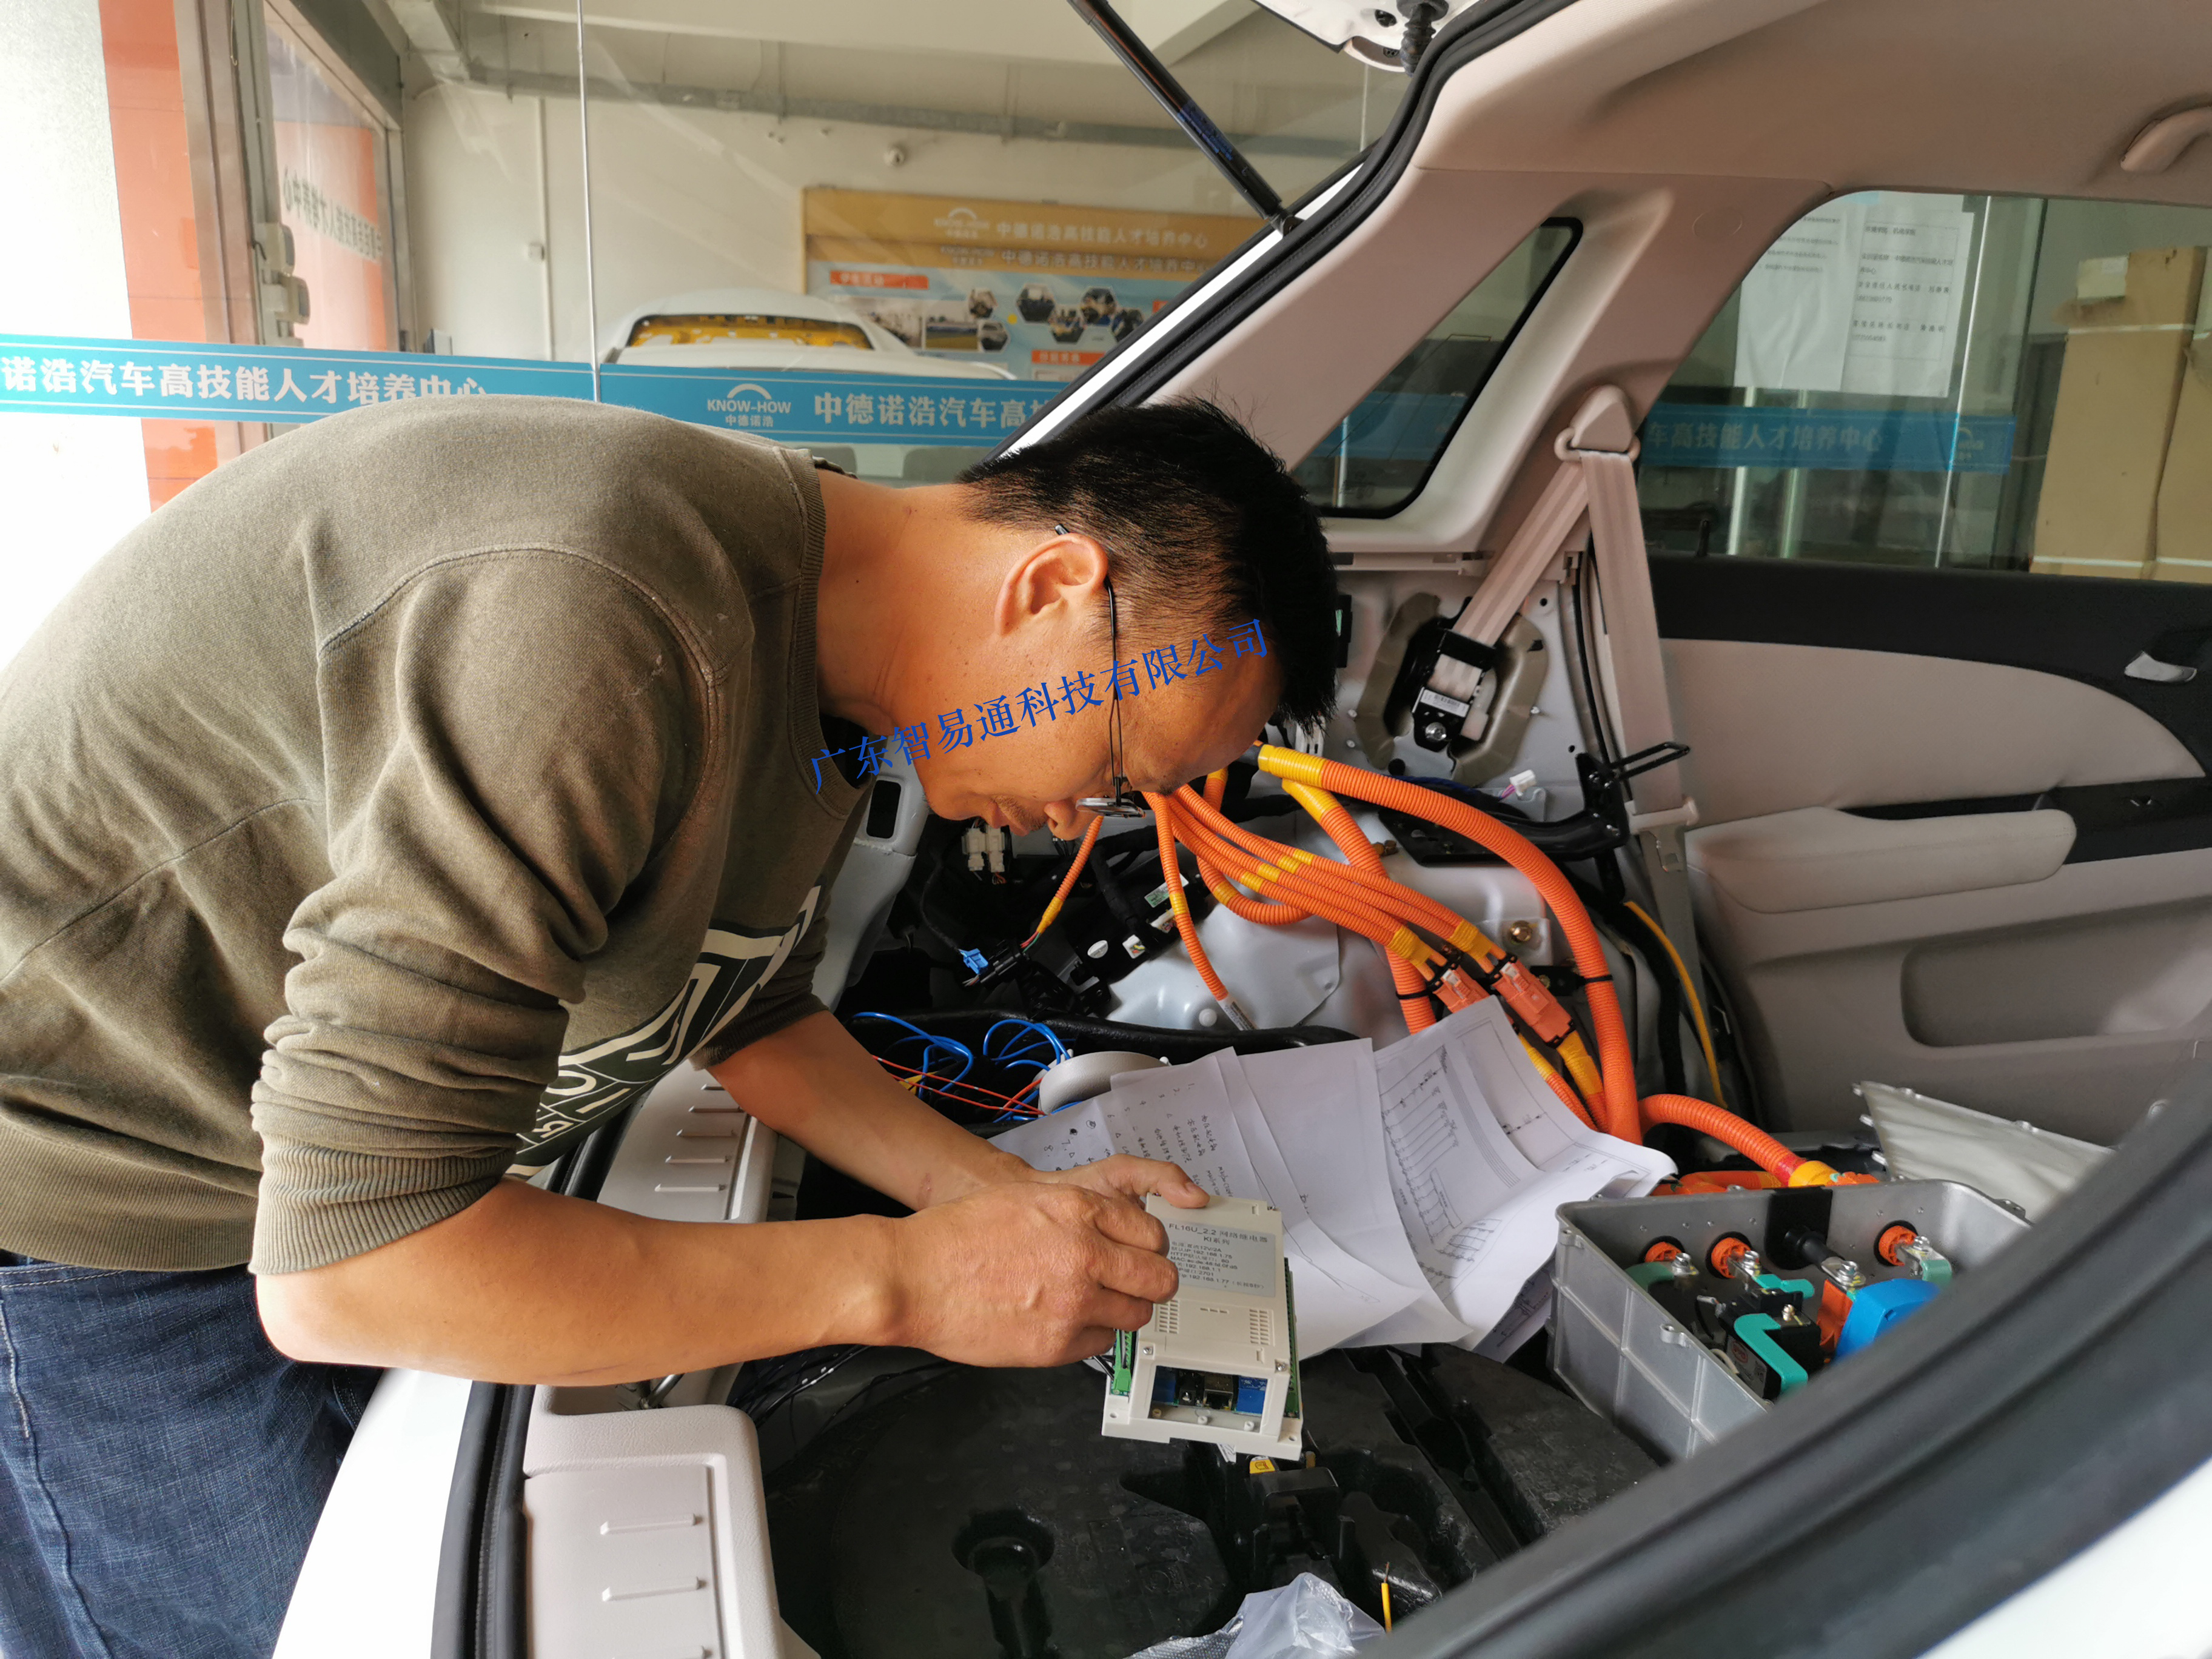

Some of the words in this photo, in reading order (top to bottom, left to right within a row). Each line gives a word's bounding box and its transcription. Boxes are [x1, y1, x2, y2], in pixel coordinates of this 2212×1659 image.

[1, 357, 486, 405] 诺浩汽车高技能人才培养中心
[707, 398, 791, 414] KNOW-HOW
[725, 414, 773, 428] 中德诺浩
[1169, 1223, 1216, 1236] FL16U_2.2
